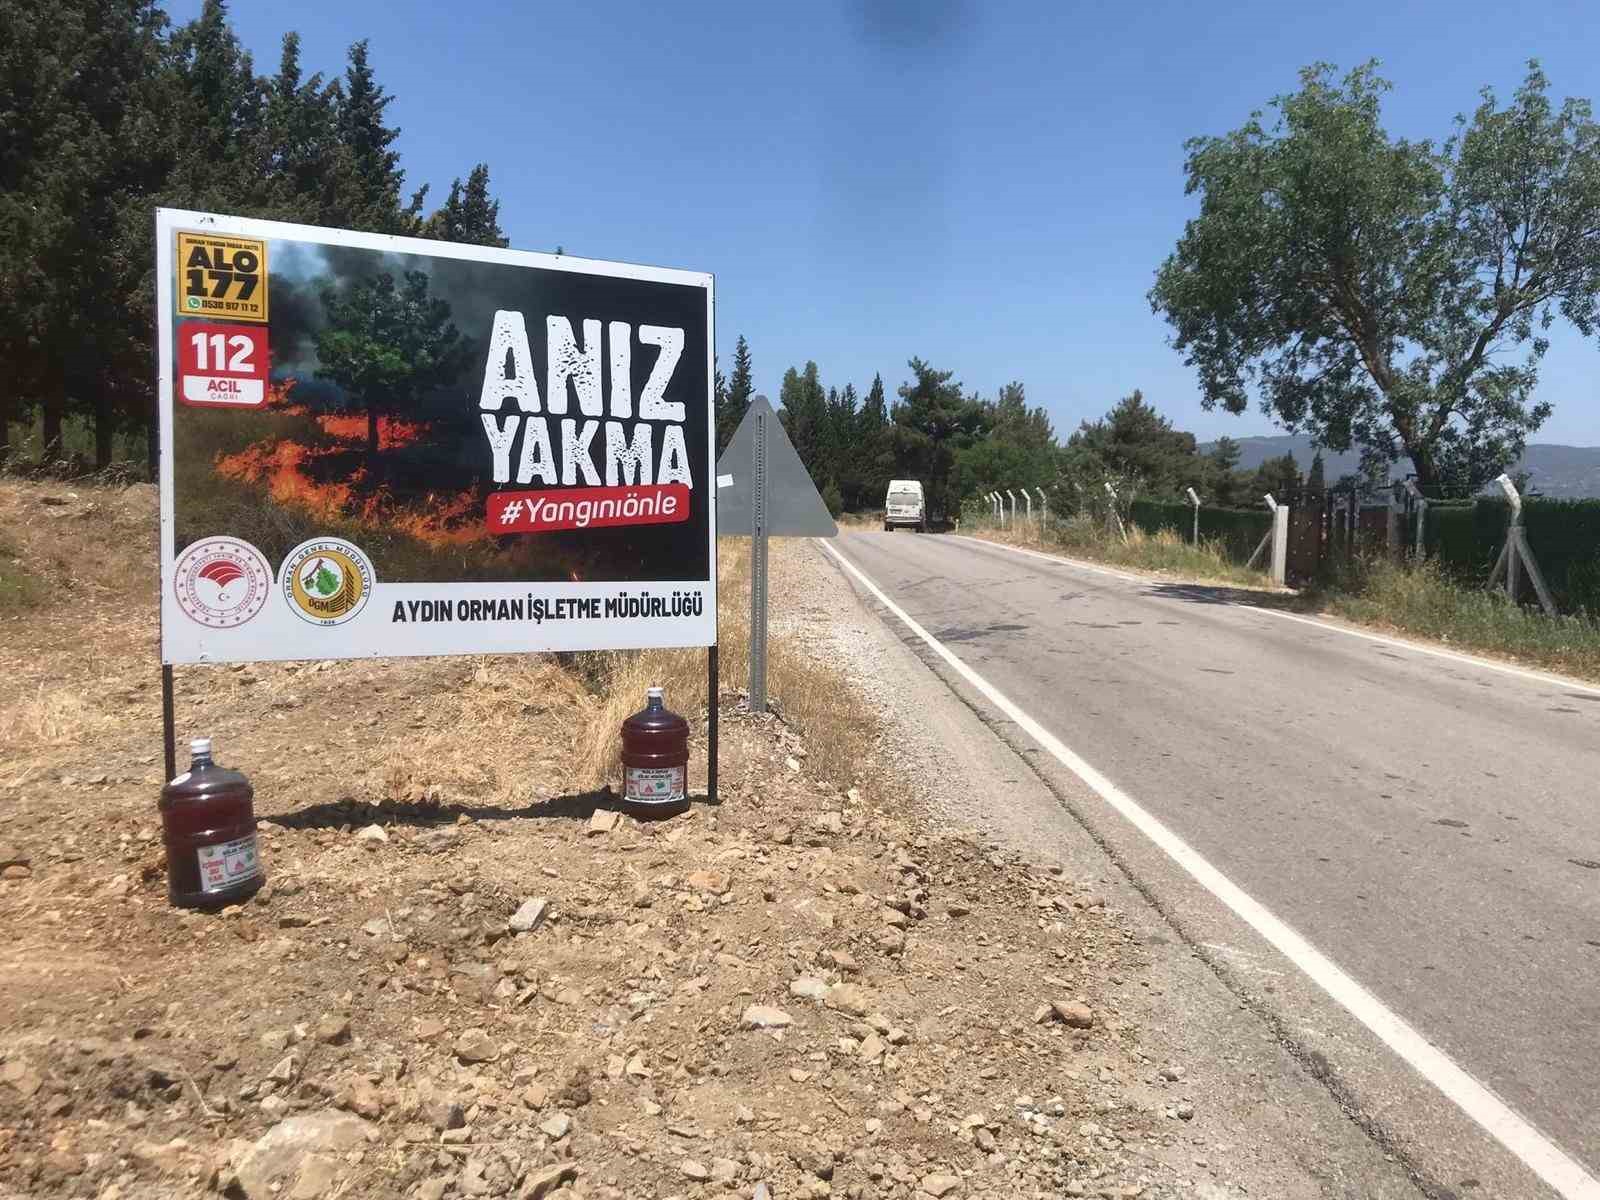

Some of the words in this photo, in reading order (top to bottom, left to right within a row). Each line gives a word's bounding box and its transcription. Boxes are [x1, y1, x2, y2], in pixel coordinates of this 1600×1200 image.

[187, 246, 259, 273] ALO
[186, 269, 259, 300] 177
[241, 303, 248, 311] 11
[250, 304, 259, 312] 12
[192, 332, 255, 372] 112
[479, 310, 686, 422] ANIZ
[481, 413, 693, 489] YAKMA
[500, 490, 677, 528] #Yangınıönle
[392, 600, 453, 622] AYDIN
[457, 599, 524, 621] ORMAN
[528, 593, 601, 624] İŞLETME
[604, 591, 703, 618] MÜDÜRLÜĞÜ
